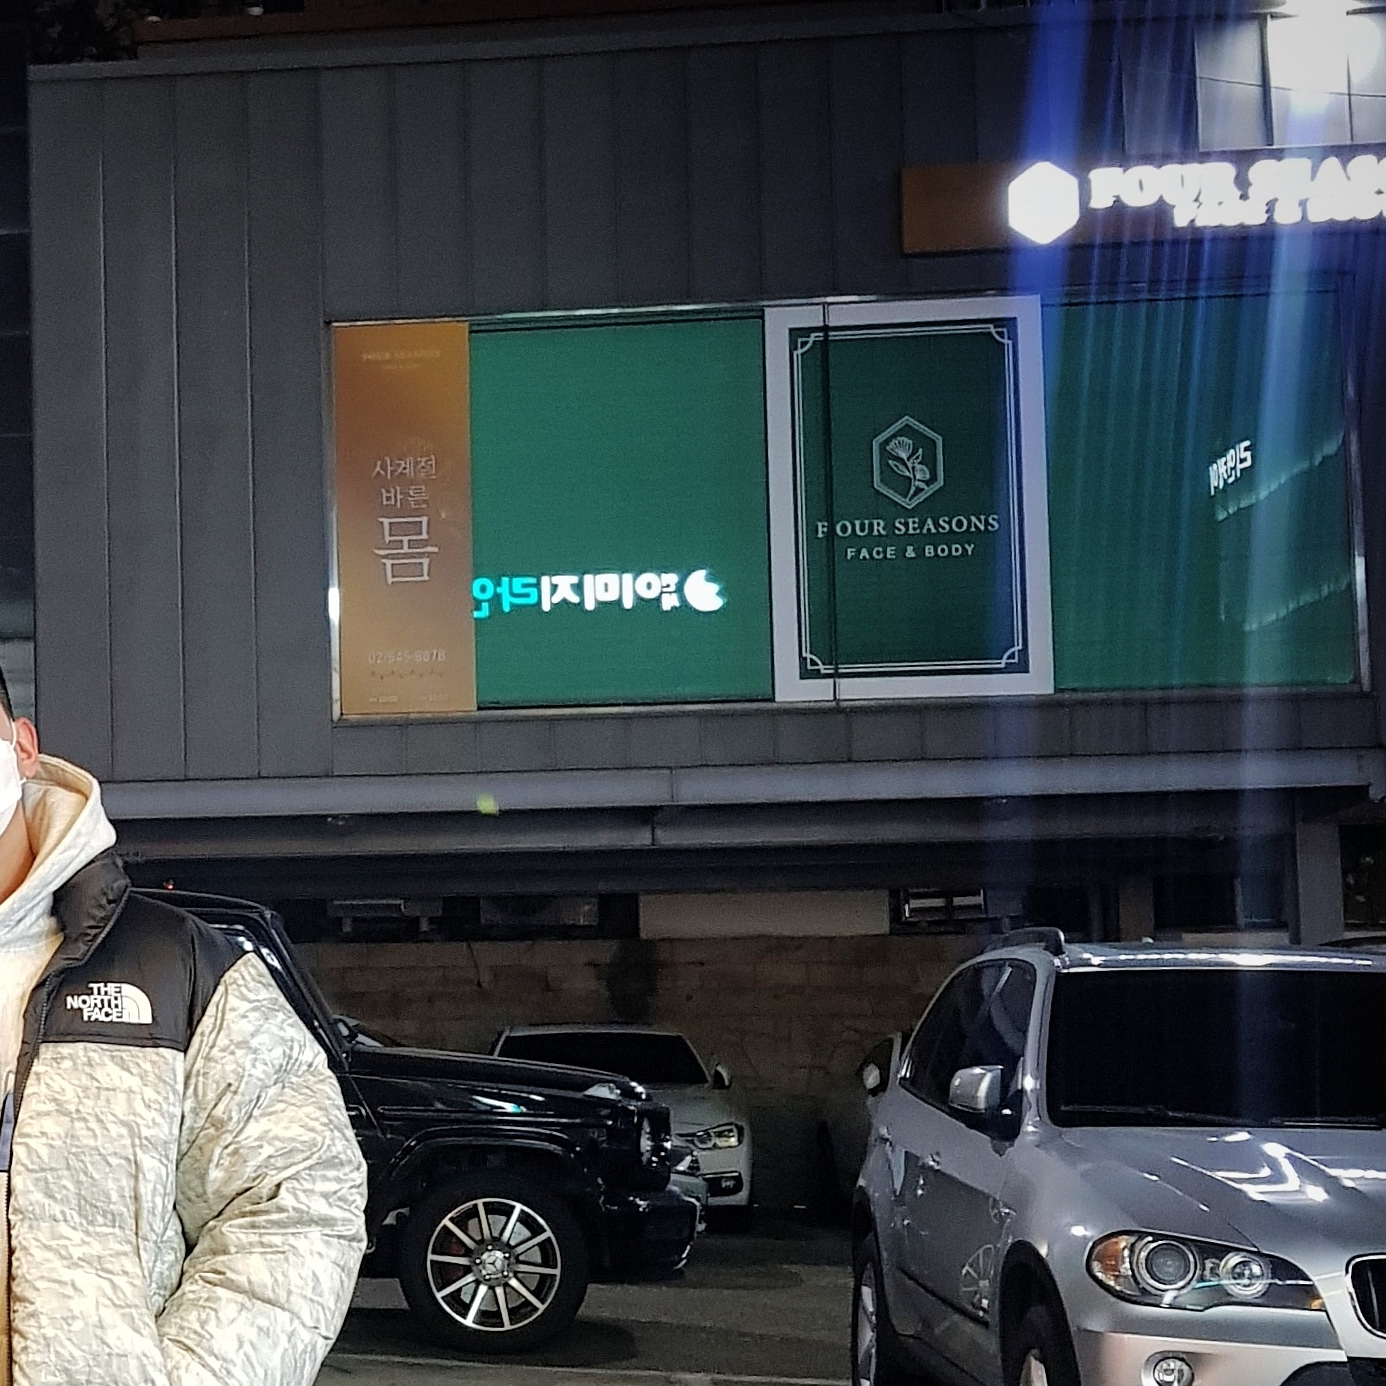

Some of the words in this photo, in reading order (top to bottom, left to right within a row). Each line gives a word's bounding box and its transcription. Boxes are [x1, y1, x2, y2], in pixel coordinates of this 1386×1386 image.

[371, 455, 438, 480] 사계절
[381, 485, 428, 508] 바른
[817, 518, 887, 538] FOUR
[895, 514, 1000, 535] SEASONS
[373, 516, 439, 585] 몸
[847, 546, 896, 560] FACE
[905, 545, 917, 558] &
[925, 543, 975, 557] BODY
[88, 983, 122, 996] THE
[66, 994, 122, 1010] NORTH
[83, 1007, 123, 1022] FACE
